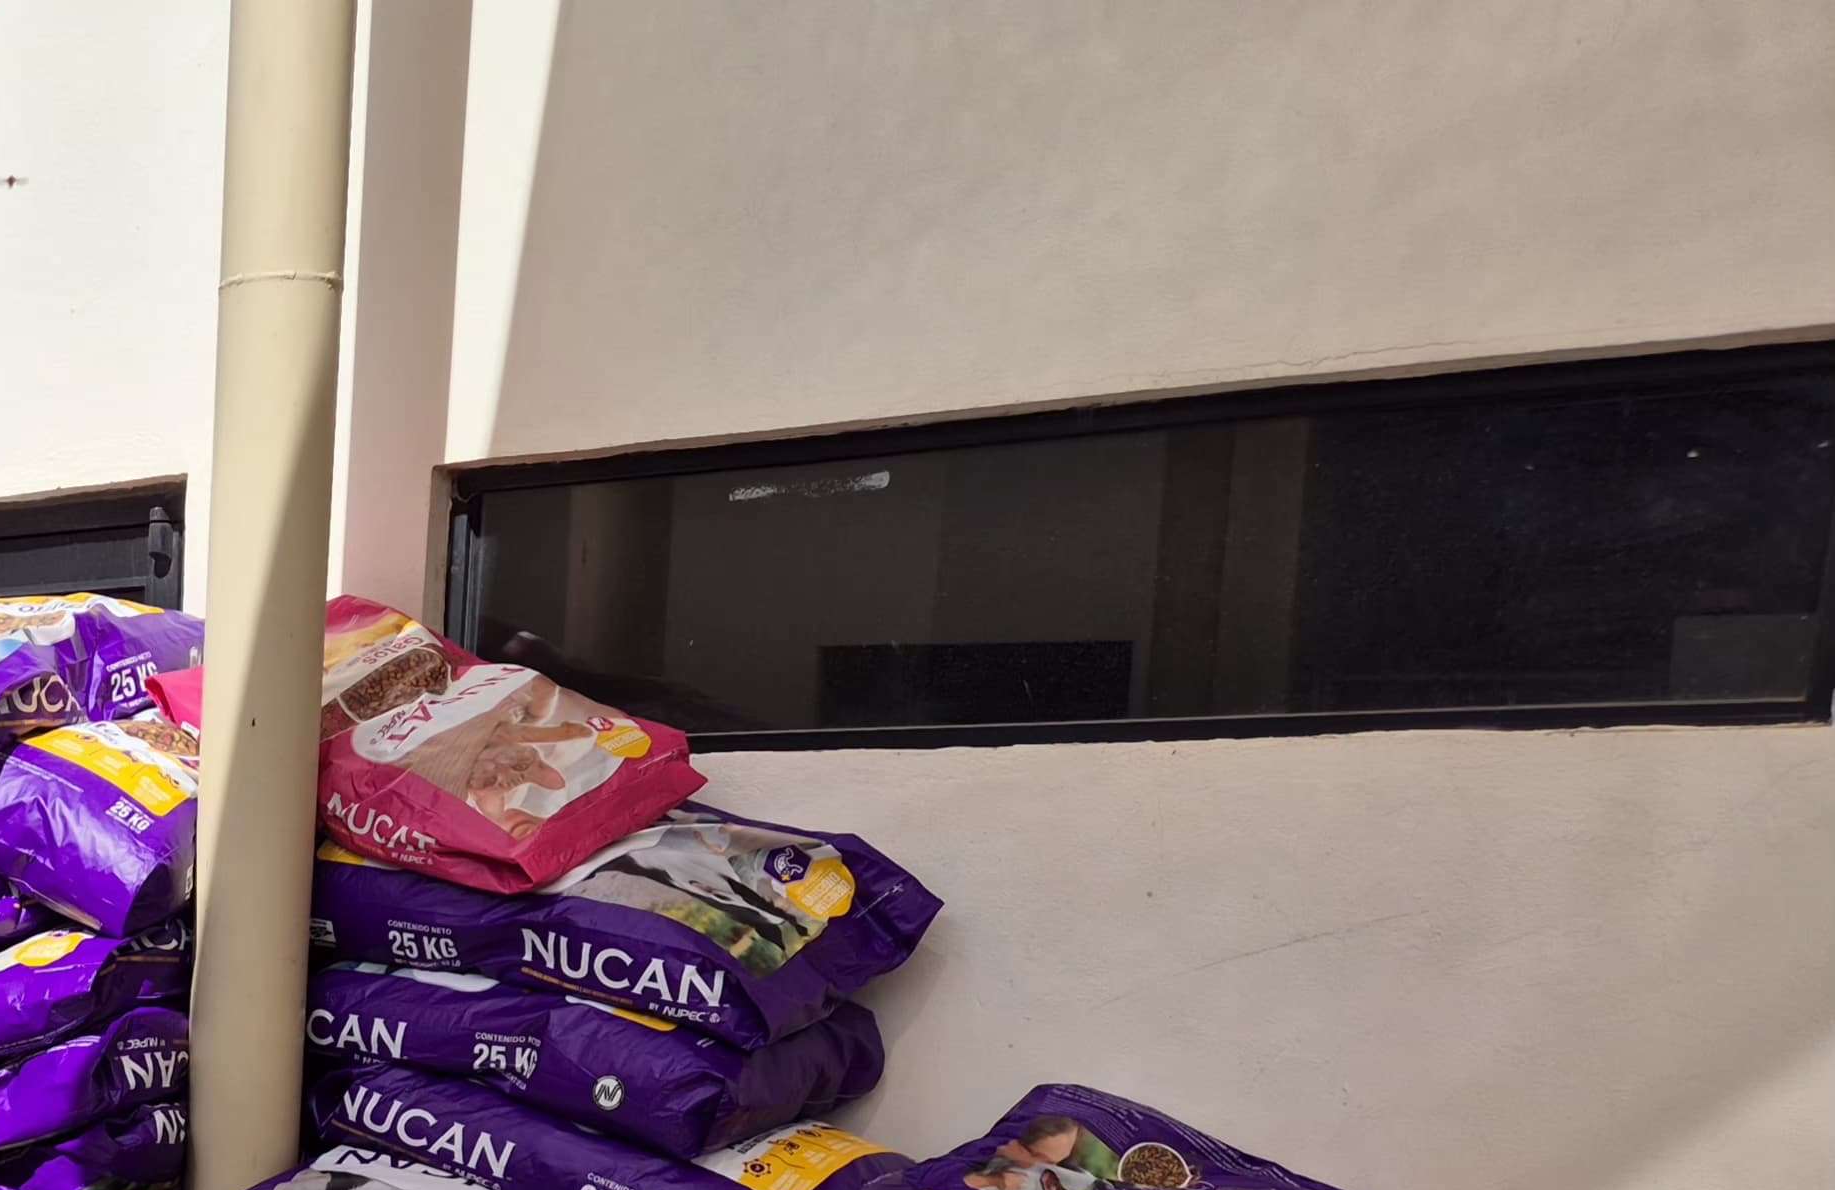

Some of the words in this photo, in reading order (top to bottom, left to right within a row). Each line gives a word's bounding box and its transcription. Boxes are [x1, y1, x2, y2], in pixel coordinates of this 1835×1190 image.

[110, 667, 136, 702] 25
[108, 800, 130, 817] 25
[326, 792, 442, 855] NUCAT
[387, 919, 428, 932] CONTENIDO
[430, 925, 452, 935] NETO
[389, 930, 420, 960] 25
[423, 934, 458, 960] KG
[520, 928, 726, 1008] NUCAN
[649, 1002, 660, 1011] BY
[662, 1006, 707, 1023] NUPEC
[307, 1008, 408, 1060] CAN
[475, 1031, 526, 1044] CONTENIDO
[473, 1042, 508, 1071] 25
